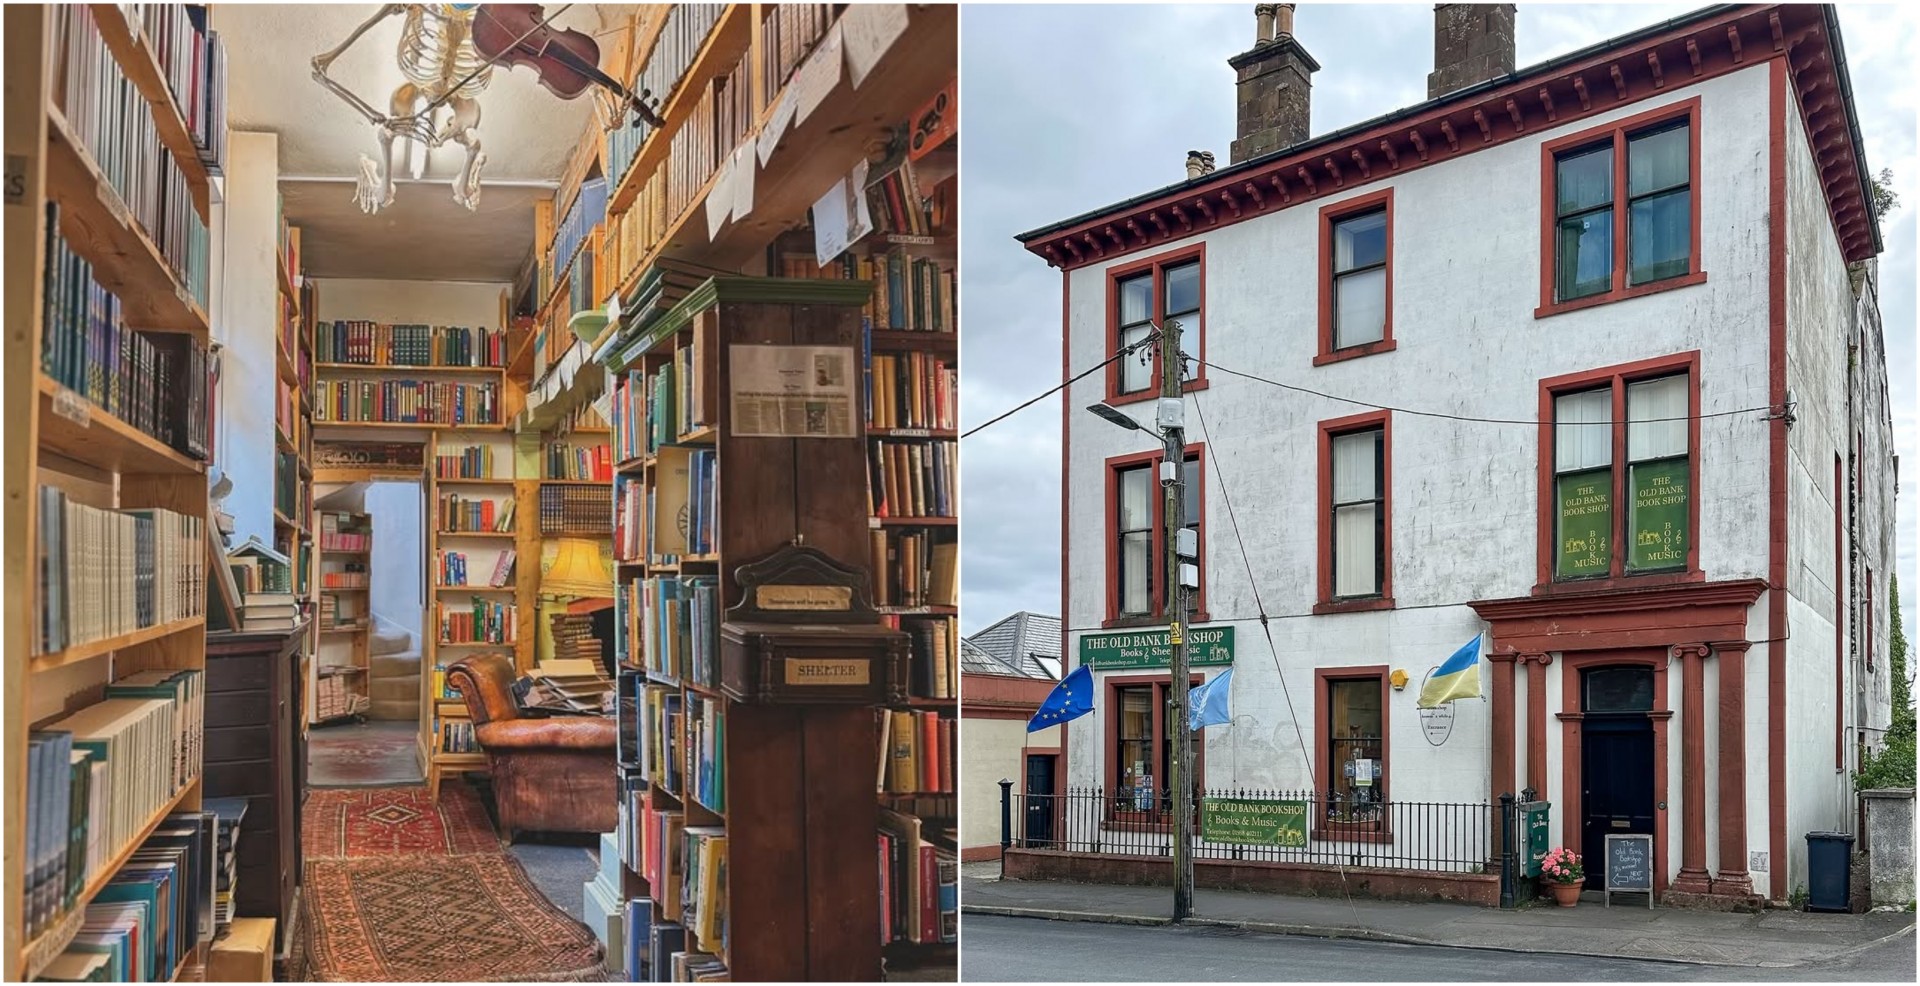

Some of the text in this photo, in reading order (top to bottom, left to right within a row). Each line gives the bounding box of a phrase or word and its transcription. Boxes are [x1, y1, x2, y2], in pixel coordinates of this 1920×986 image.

[1652, 477, 1671, 486] THE
[1577, 486, 1594, 495] THE
[1639, 485, 1684, 497] OLD BANK
[1565, 494, 1607, 507] OLD BANK
[1636, 495, 1687, 508] BOOK SHOP
[1563, 504, 1610, 517] BOOK SHOP
[1647, 551, 1682, 561] MUSIC
[1574, 557, 1606, 568] MUSIC
[1086, 638, 1108, 649] THE
[1109, 636, 1131, 648] OLD
[1133, 634, 1161, 647] BANK
[1164, 631, 1223, 646] BKSHOP
[1120, 648, 1143, 657] Books
[1151, 646, 1171, 656] Shee
[797, 665, 857, 676] SHELTER
[1205, 802, 1305, 815] THE OLD BANK BOOKSHOP
[1215, 815, 1277, 827] Books & Music
